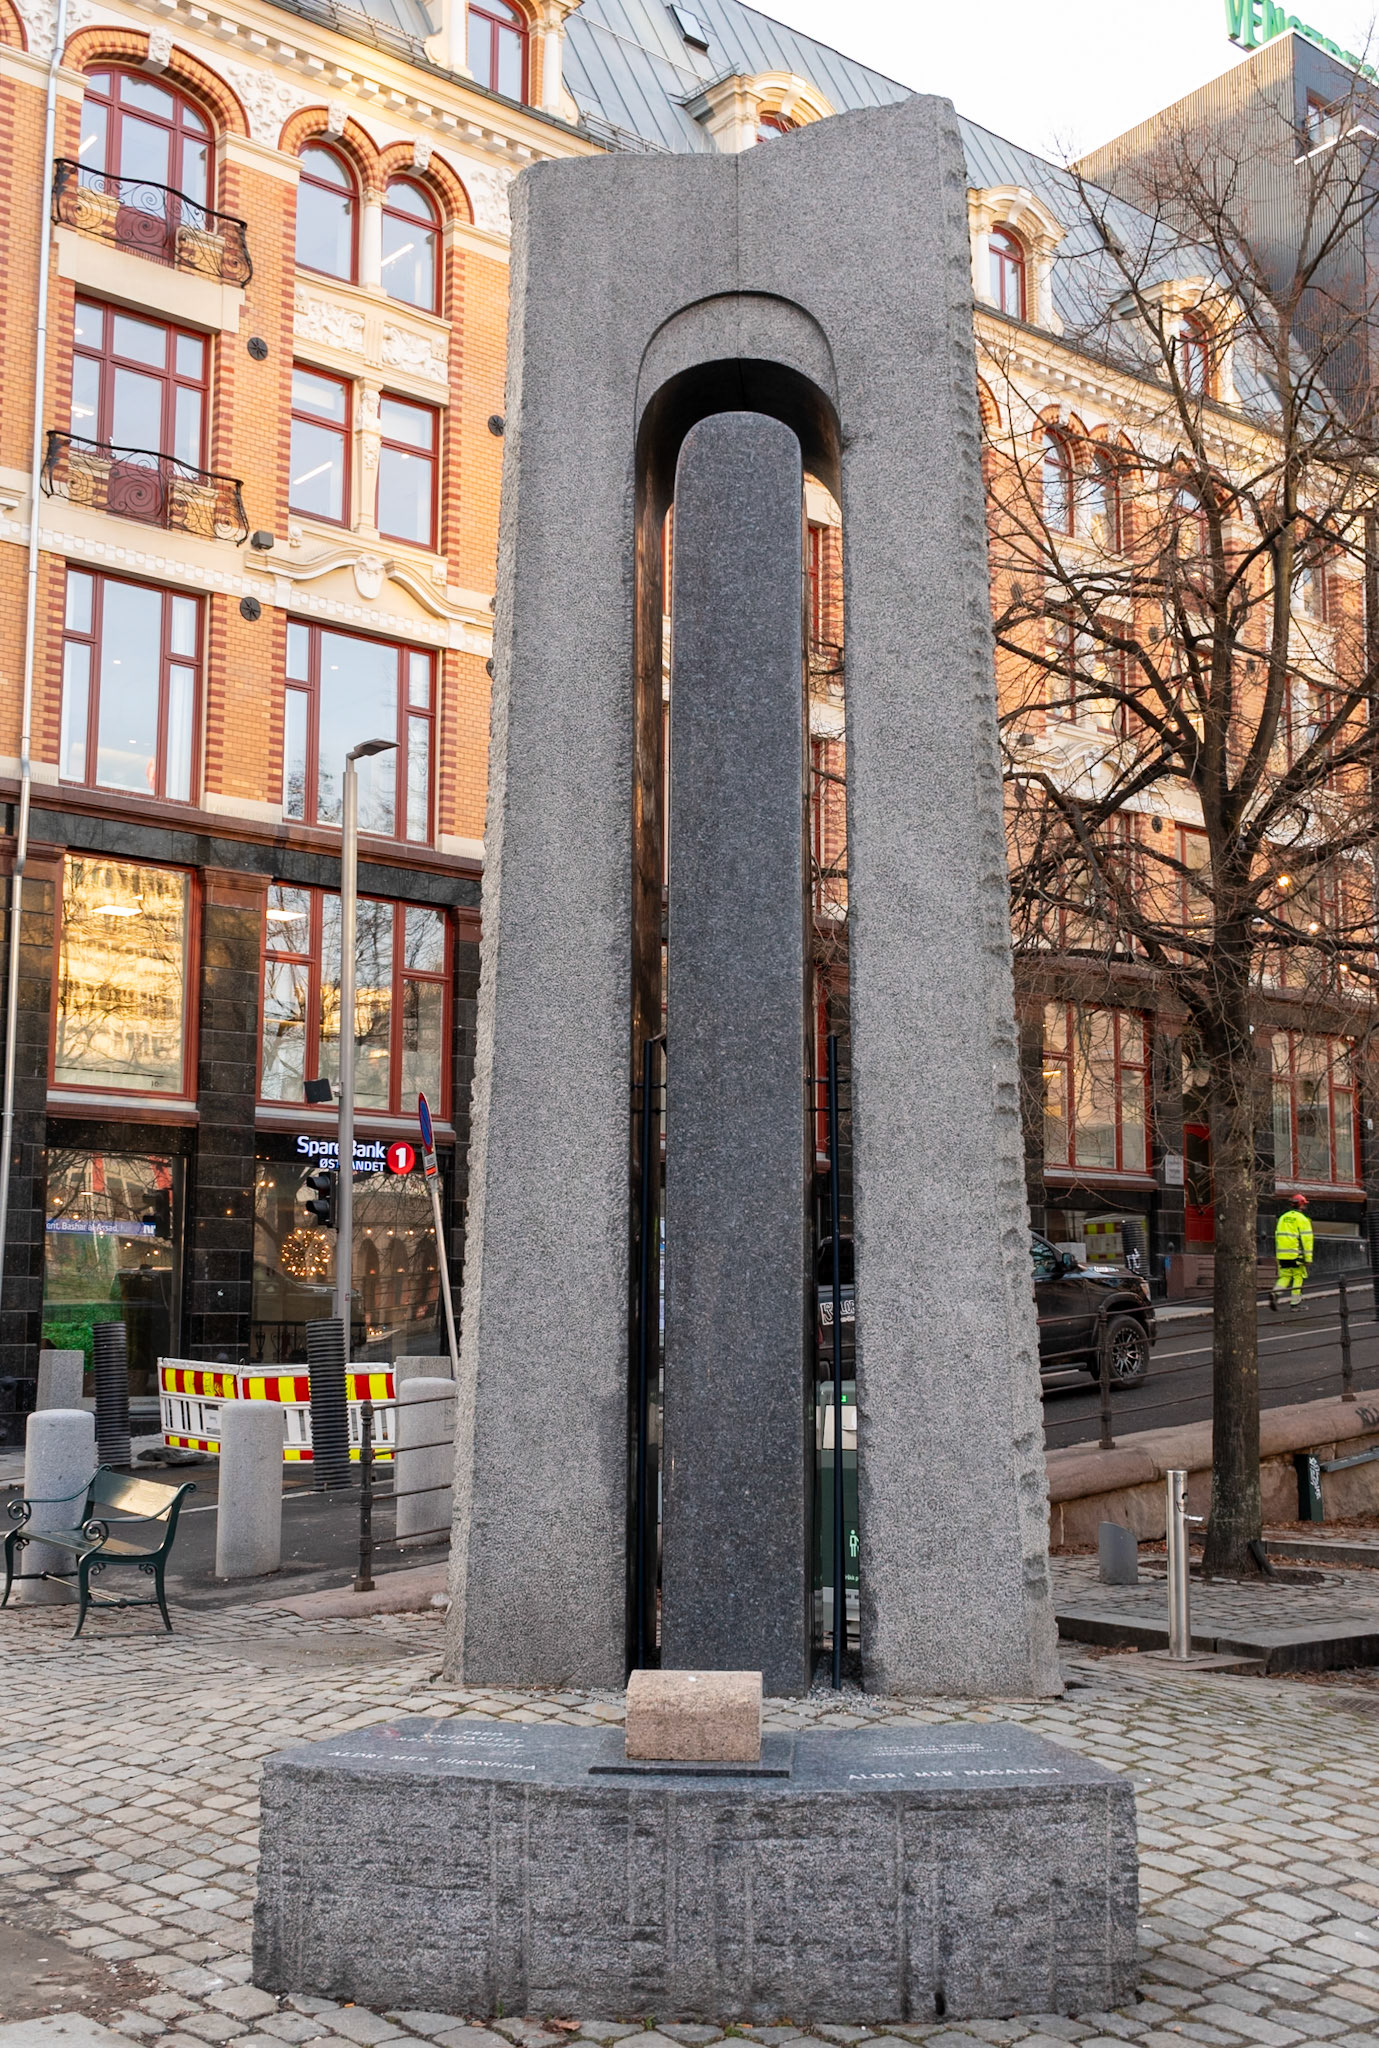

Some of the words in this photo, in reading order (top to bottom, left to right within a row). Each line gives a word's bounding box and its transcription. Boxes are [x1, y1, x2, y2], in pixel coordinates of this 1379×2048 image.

[396, 1147, 407, 1168] 1
[327, 1751, 385, 1759] ALDRI
[436, 1757, 536, 1771] HIROSHIMA
[848, 1772, 906, 1780] ALDRI
[963, 1767, 1062, 1776] NAGASAKI
